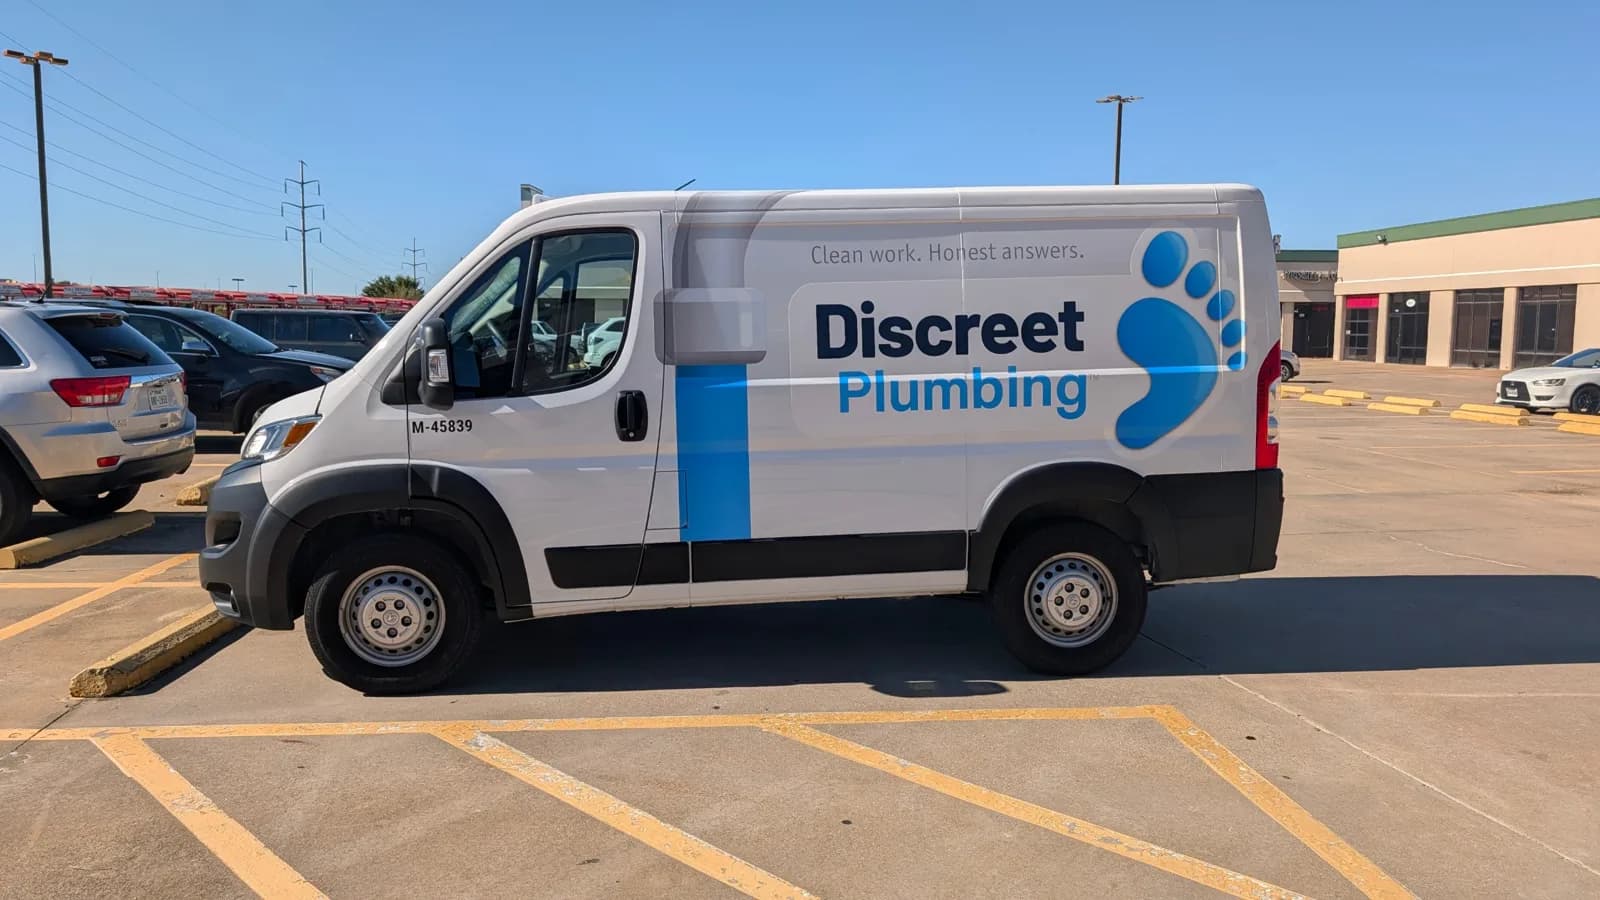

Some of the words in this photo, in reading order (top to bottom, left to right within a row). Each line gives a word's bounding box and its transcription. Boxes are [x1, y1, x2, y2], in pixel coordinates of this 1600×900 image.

[811, 244, 863, 264] Clean
[869, 243, 922, 262] work.
[929, 243, 997, 261] Honest
[1002, 244, 1085, 260] answers.
[816, 300, 1085, 359] Discreet
[839, 365, 1087, 420] Plumbing
[412, 419, 473, 433] M-45839
